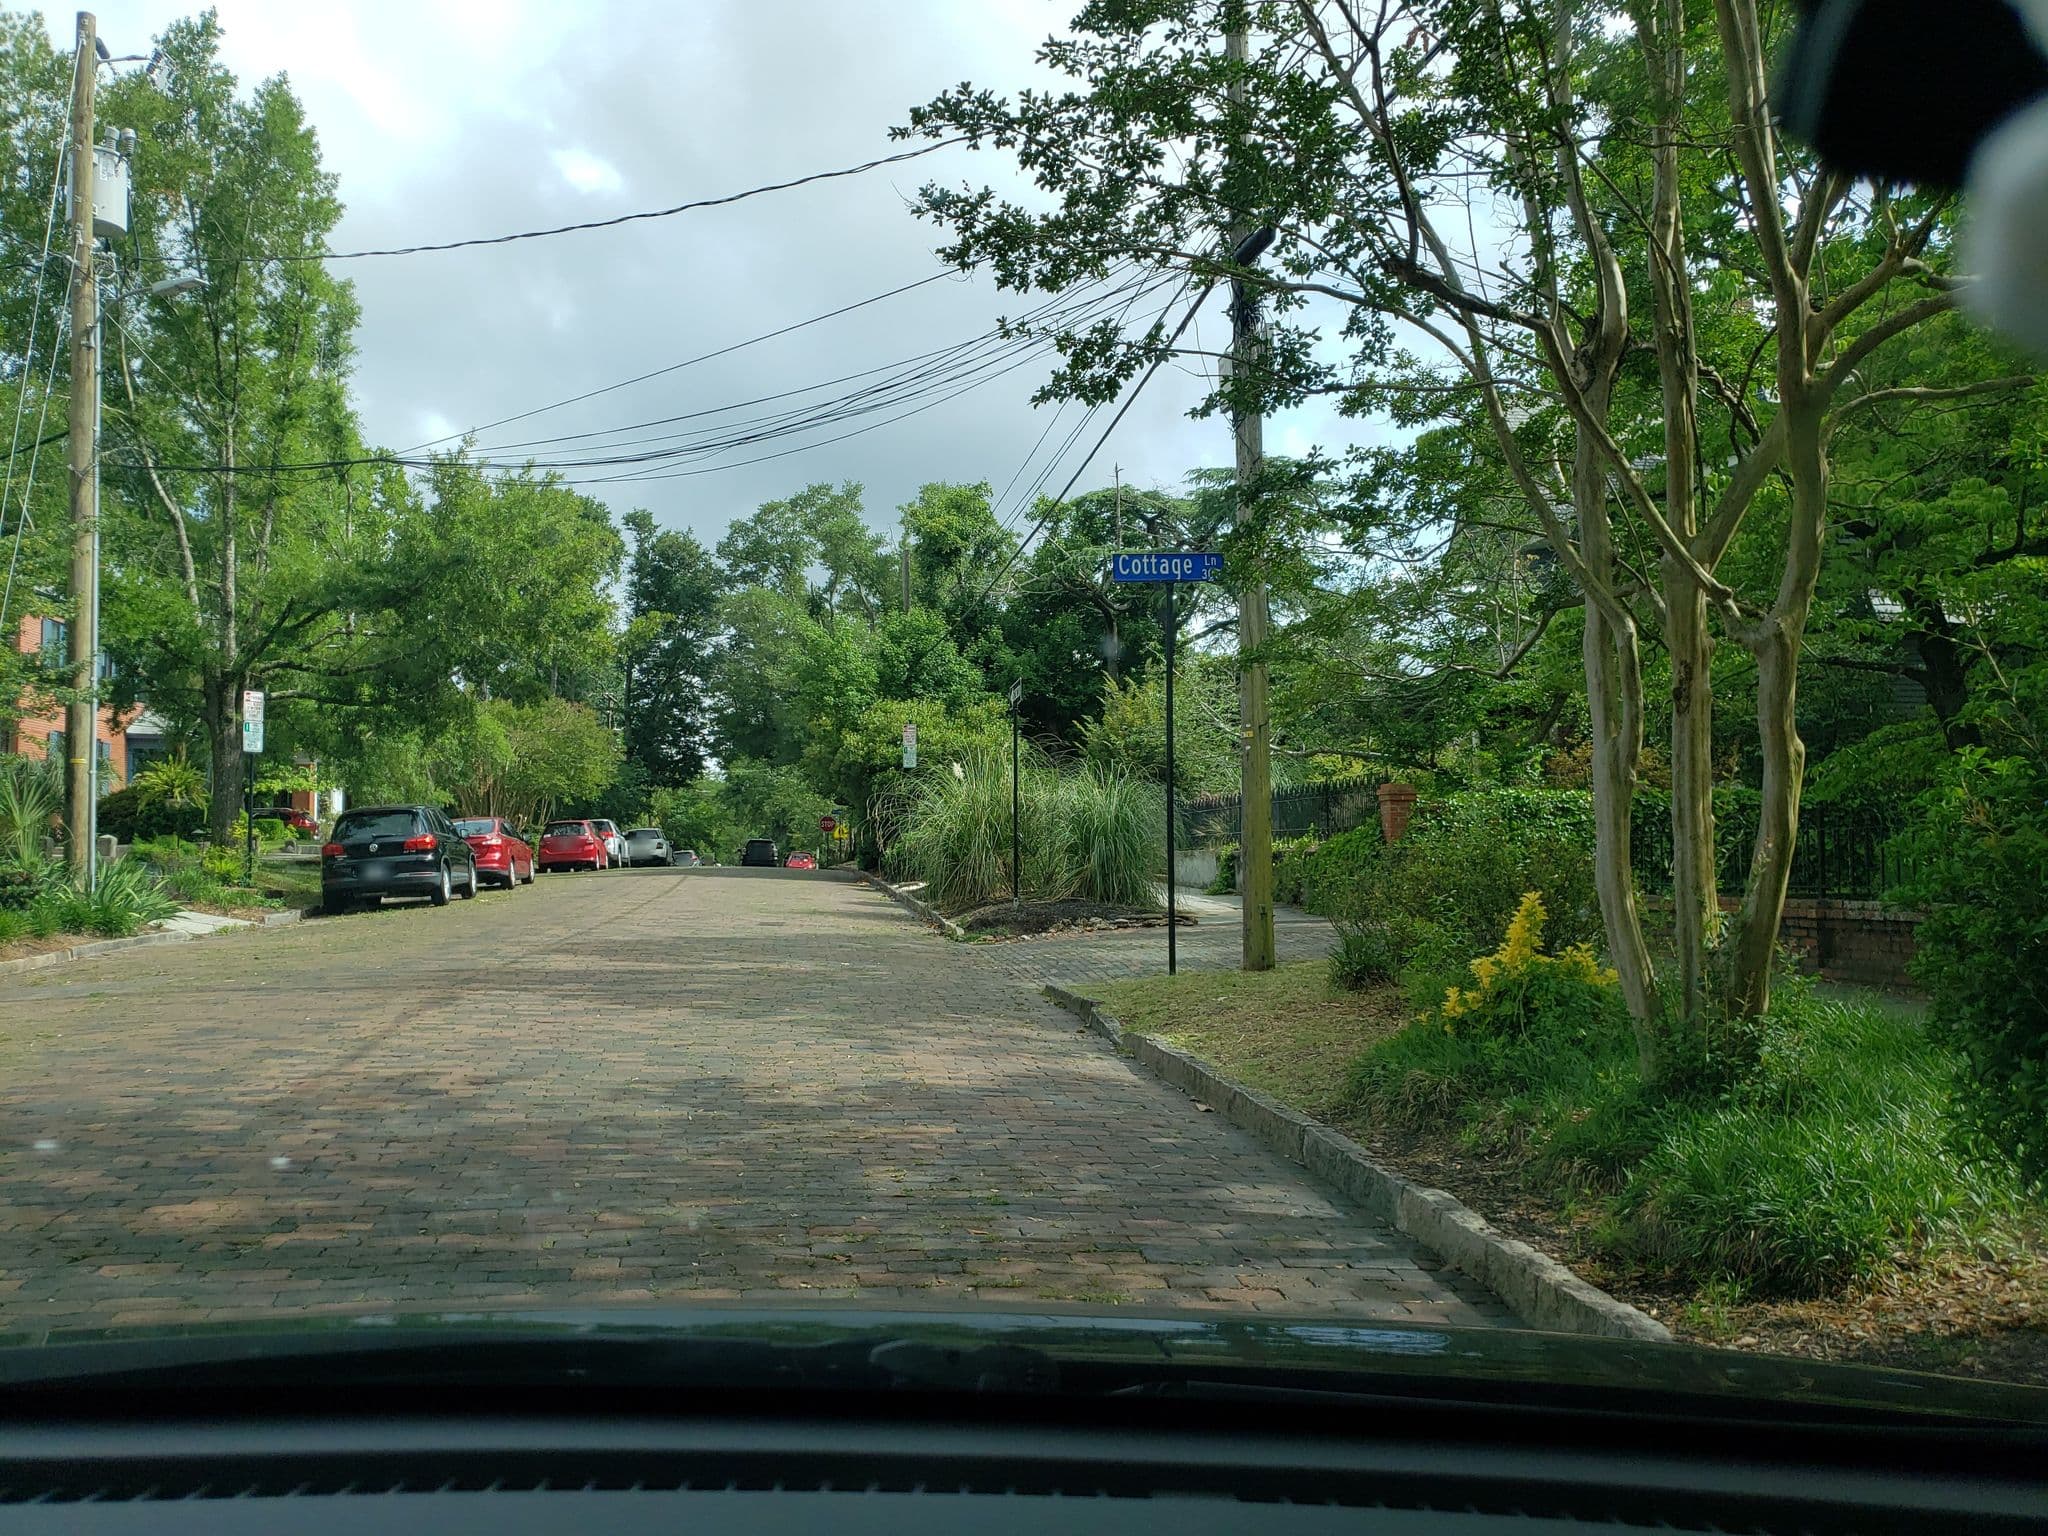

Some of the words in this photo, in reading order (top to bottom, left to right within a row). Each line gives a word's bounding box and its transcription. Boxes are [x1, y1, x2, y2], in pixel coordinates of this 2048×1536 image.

[1118, 554, 1193, 580] Cottage
[1204, 554, 1217, 566] Ln
[820, 820, 836, 828] STOP
